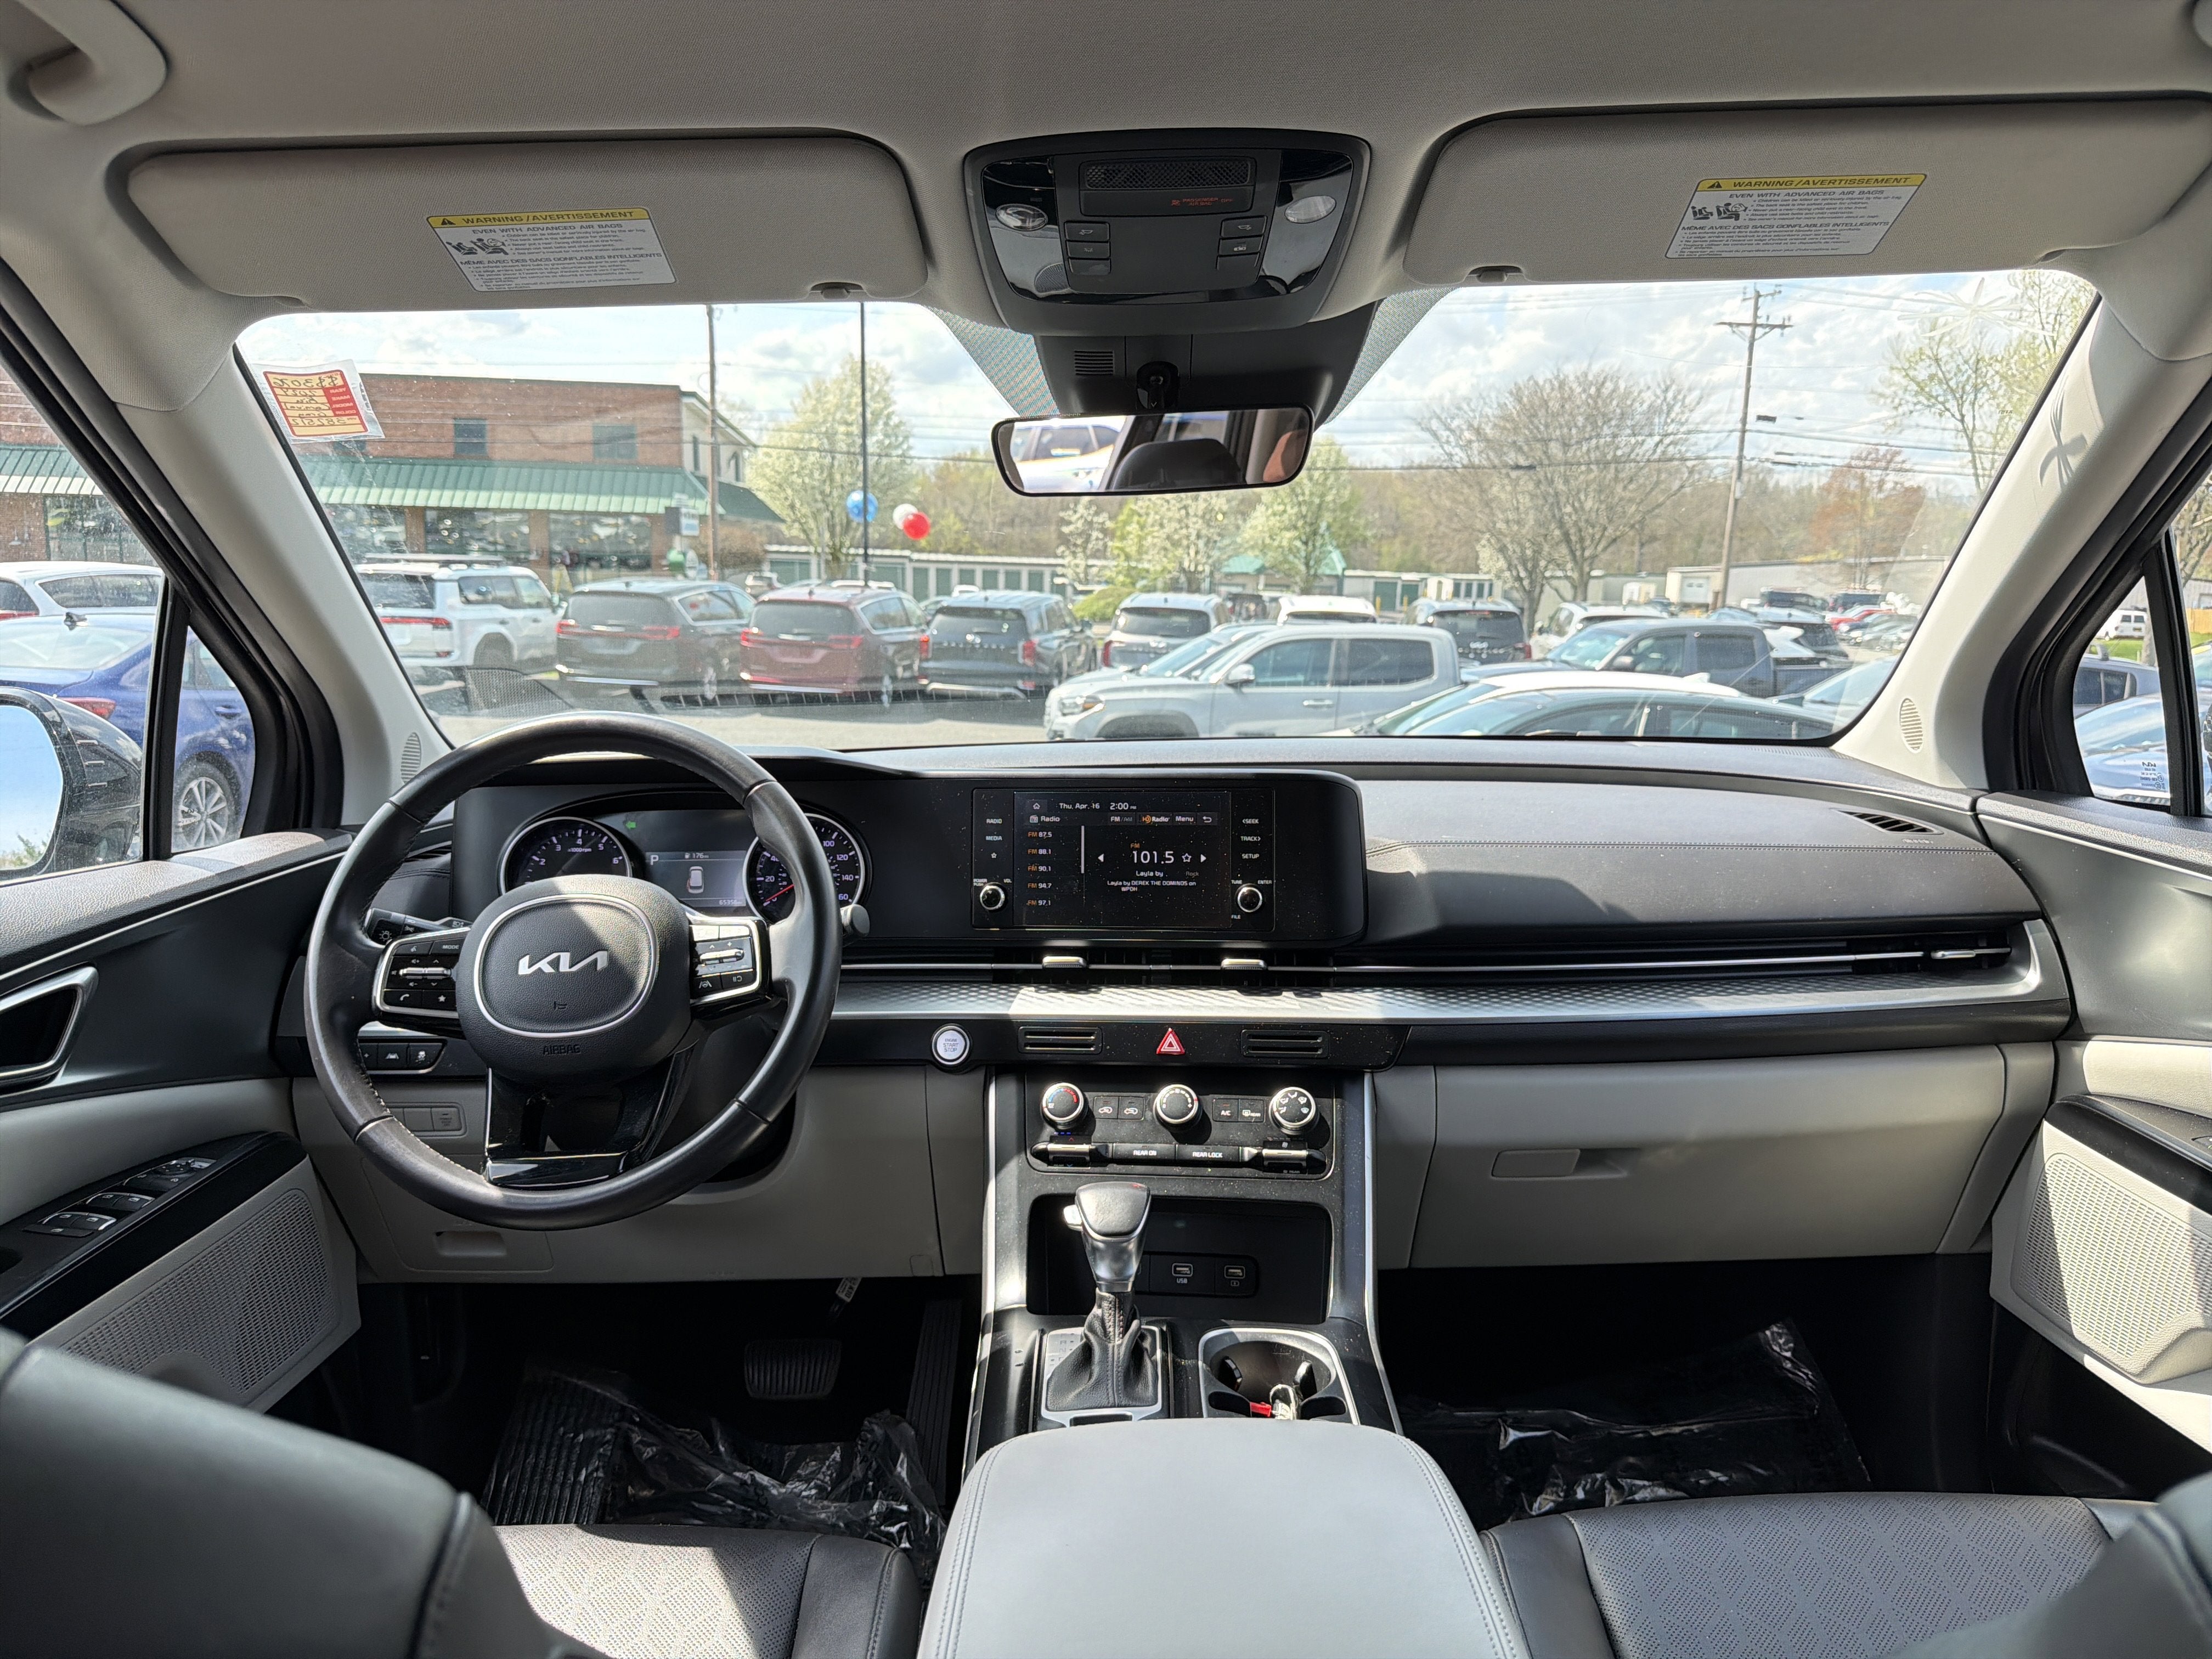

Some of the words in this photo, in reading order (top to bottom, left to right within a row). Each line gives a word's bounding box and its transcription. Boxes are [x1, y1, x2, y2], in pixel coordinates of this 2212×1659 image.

[650, 855, 659, 866] P
[1132, 851, 1174, 864] 101.5
[518, 950, 608, 975] KIA
[543, 1044, 581, 1055] AIRBAG
